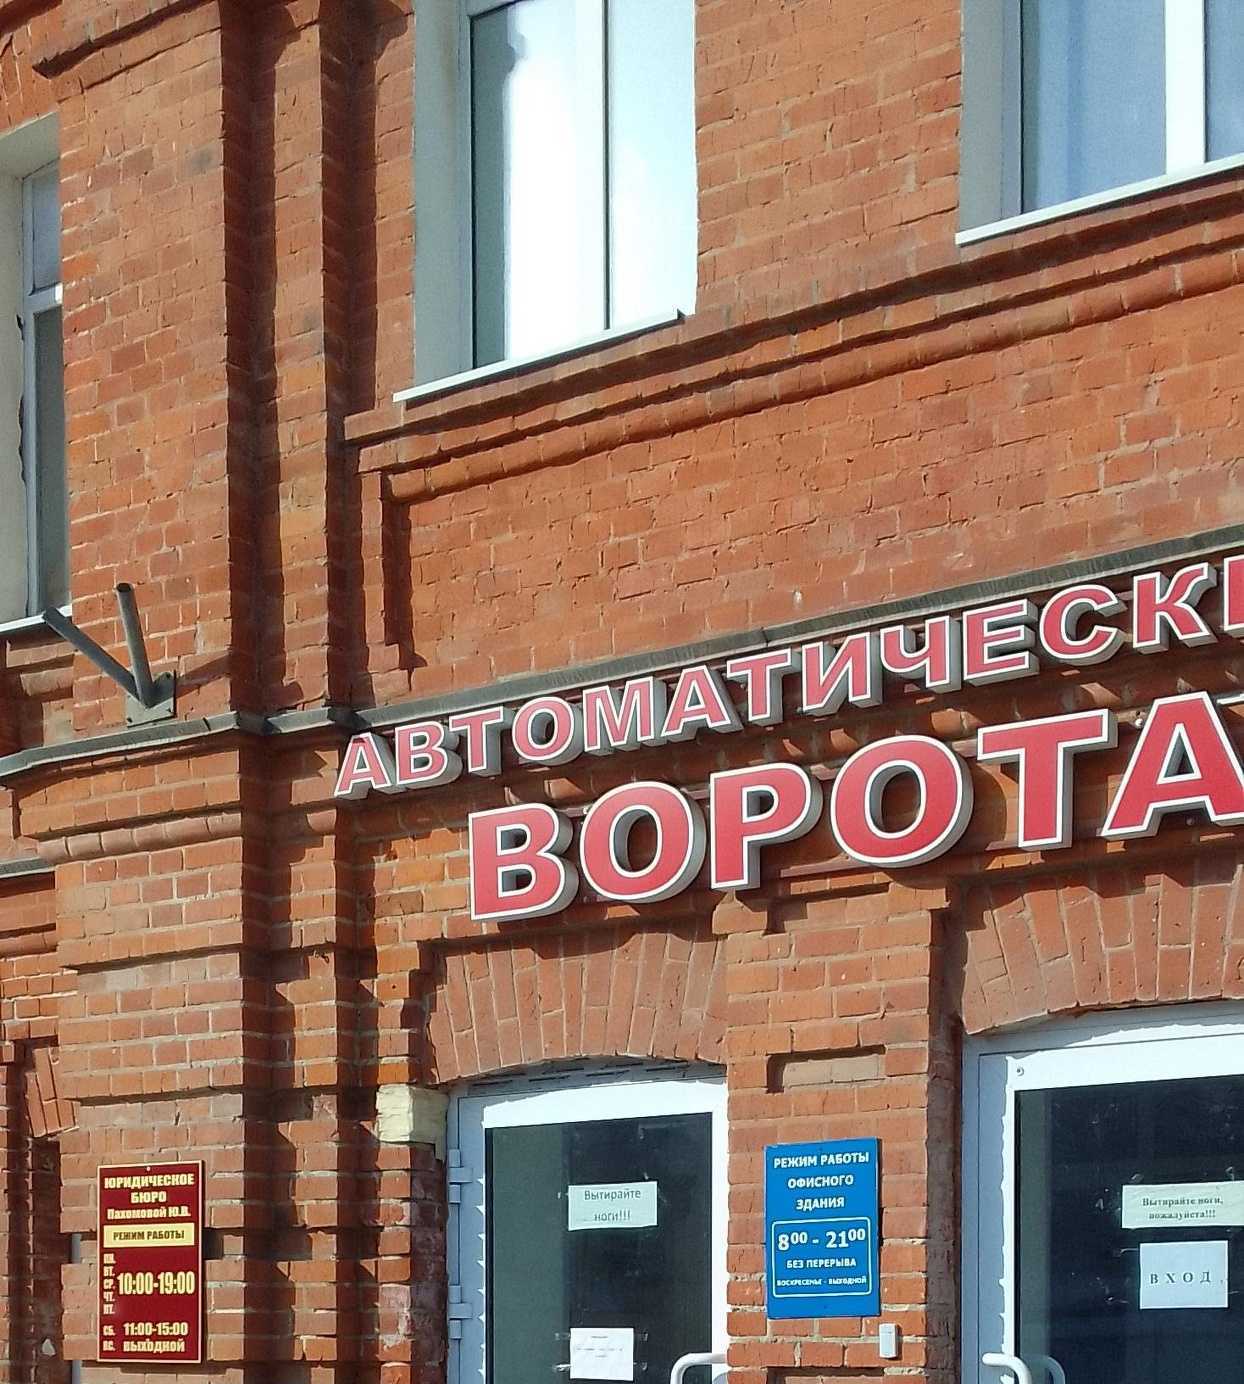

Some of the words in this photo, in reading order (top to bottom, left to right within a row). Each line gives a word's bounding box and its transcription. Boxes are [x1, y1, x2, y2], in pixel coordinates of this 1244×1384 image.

[468, 690, 1244, 922] ВОРОТА
[774, 1154, 817, 1169] РЕЖИМ
[820, 1152, 869, 1166] РАБОТЫ
[104, 1173, 195, 1189] ЮРИДИЧЕСКОЕ
[788, 1175, 854, 1189] ОФИСНОГО
[130, 1191, 167, 1203] БЮРО
[584, 1188, 641, 1201] Вытирайте
[796, 1197, 845, 1211] ЗДАНИЯ
[1142, 1197, 1196, 1208] Вытирайте
[107, 1206, 167, 1220] Пахомовой
[594, 1210, 631, 1222] ноги!!!
[1148, 1210, 1216, 1220] пожалуйста!!!
[113, 1231, 145, 1241] РЕЖИМ
[146, 1229, 185, 1241] РАБОТЫ
[786, 1259, 804, 1269] БЕЗ
[806, 1258, 857, 1268] ПЕРЕРЫВА
[117, 1271, 195, 1295] 10:00-19:00
[123, 1322, 188, 1336] 11:00-15:00
[123, 1339, 185, 1353] ВЫХОДНОЙ
